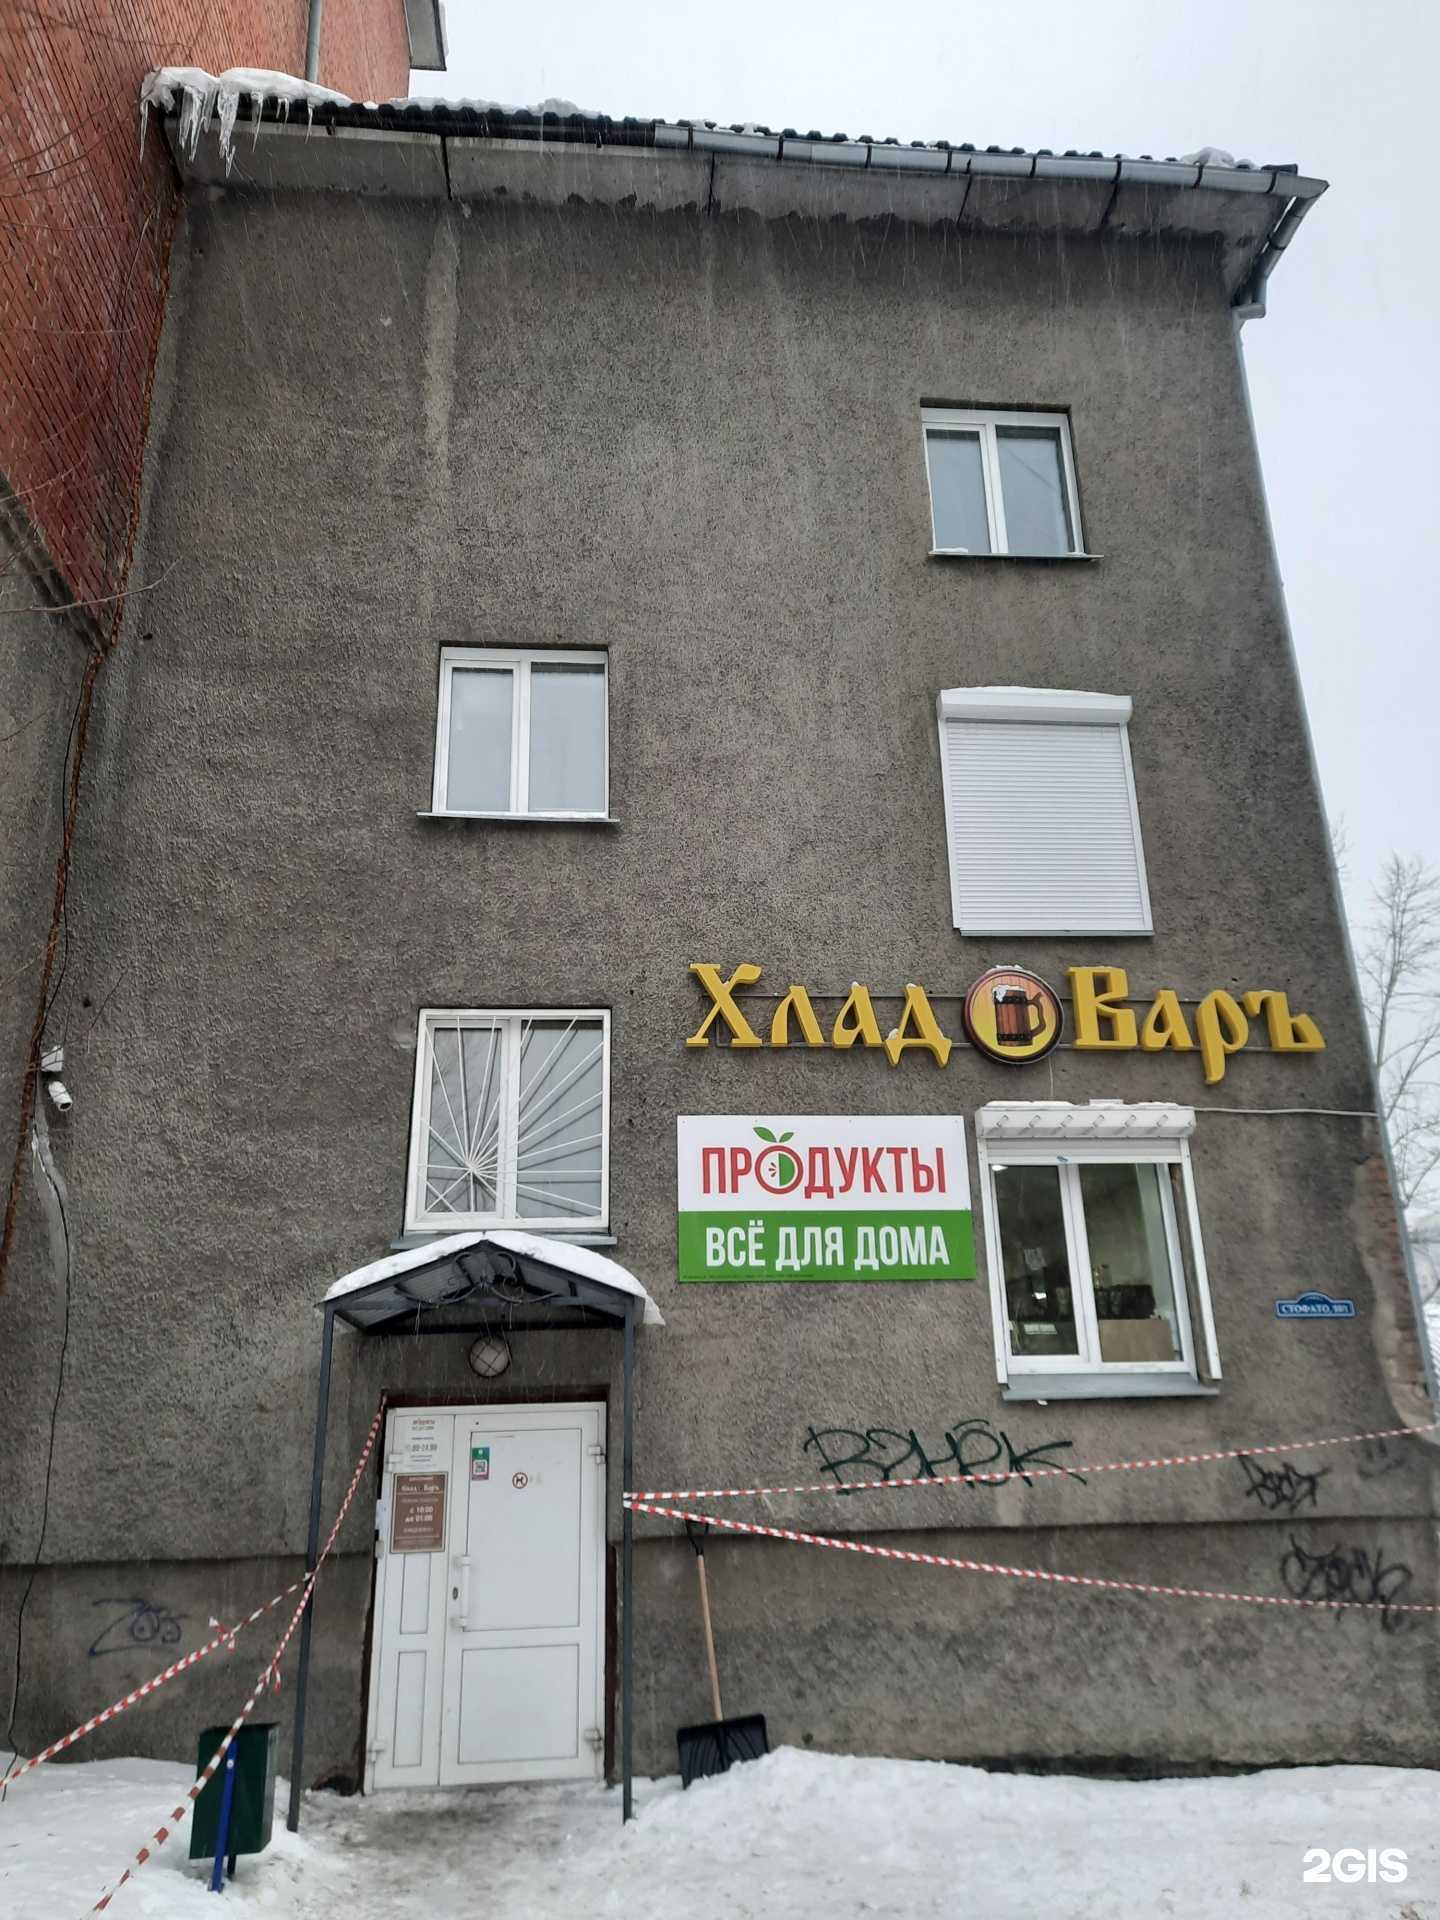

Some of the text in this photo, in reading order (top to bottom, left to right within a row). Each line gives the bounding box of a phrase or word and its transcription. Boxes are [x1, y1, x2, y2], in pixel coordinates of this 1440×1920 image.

[686, 963, 1325, 1084] Хлад Варъ
[702, 1145, 947, 1200] ПРОДУКТЫ
[706, 1220, 950, 1271] ВСЁ ДЛЯ ДОМА
